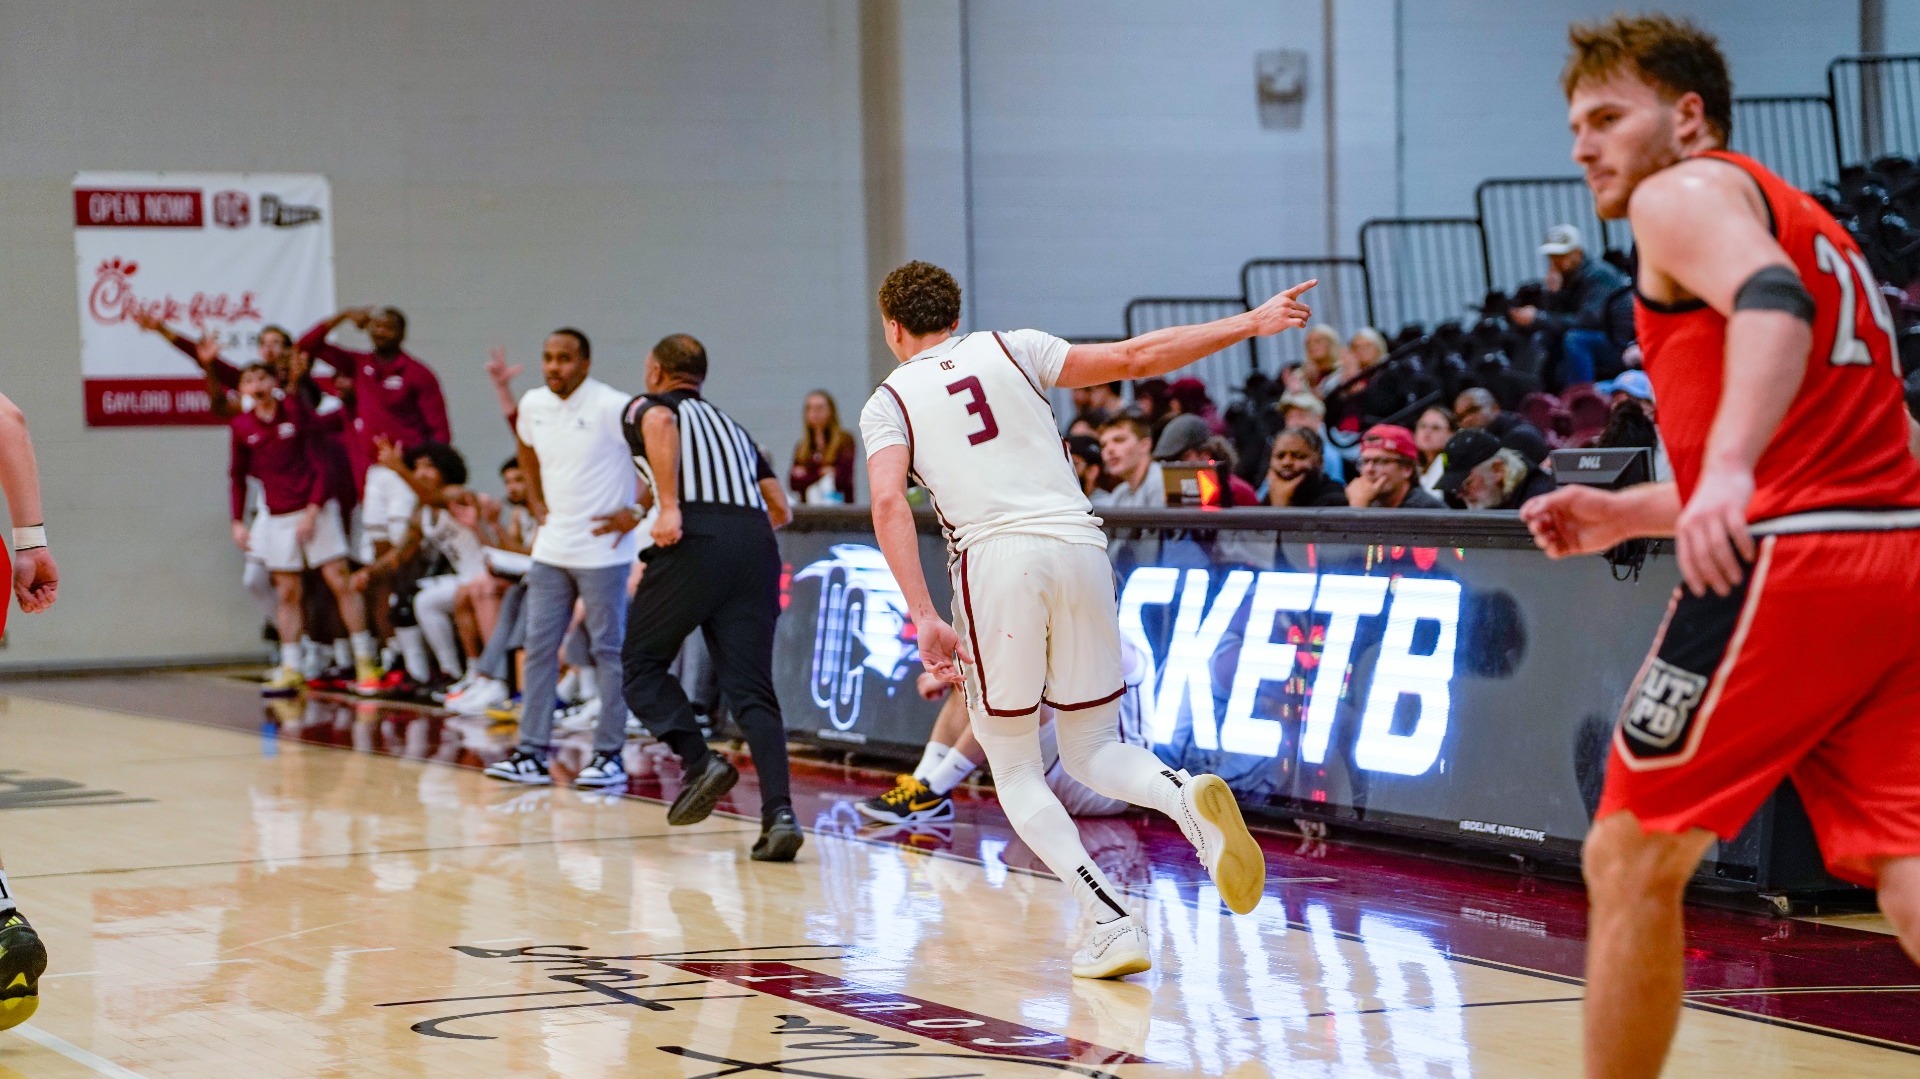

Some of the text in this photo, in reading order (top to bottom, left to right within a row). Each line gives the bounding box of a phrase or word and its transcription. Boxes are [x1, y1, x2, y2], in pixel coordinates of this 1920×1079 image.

[89, 192, 195, 223] OPEN NOW!
[945, 375, 999, 446] 3
[1578, 455, 1601, 469] DELL
[1119, 567, 1461, 777] SKETB
[736, 974, 1062, 1047] COURT
